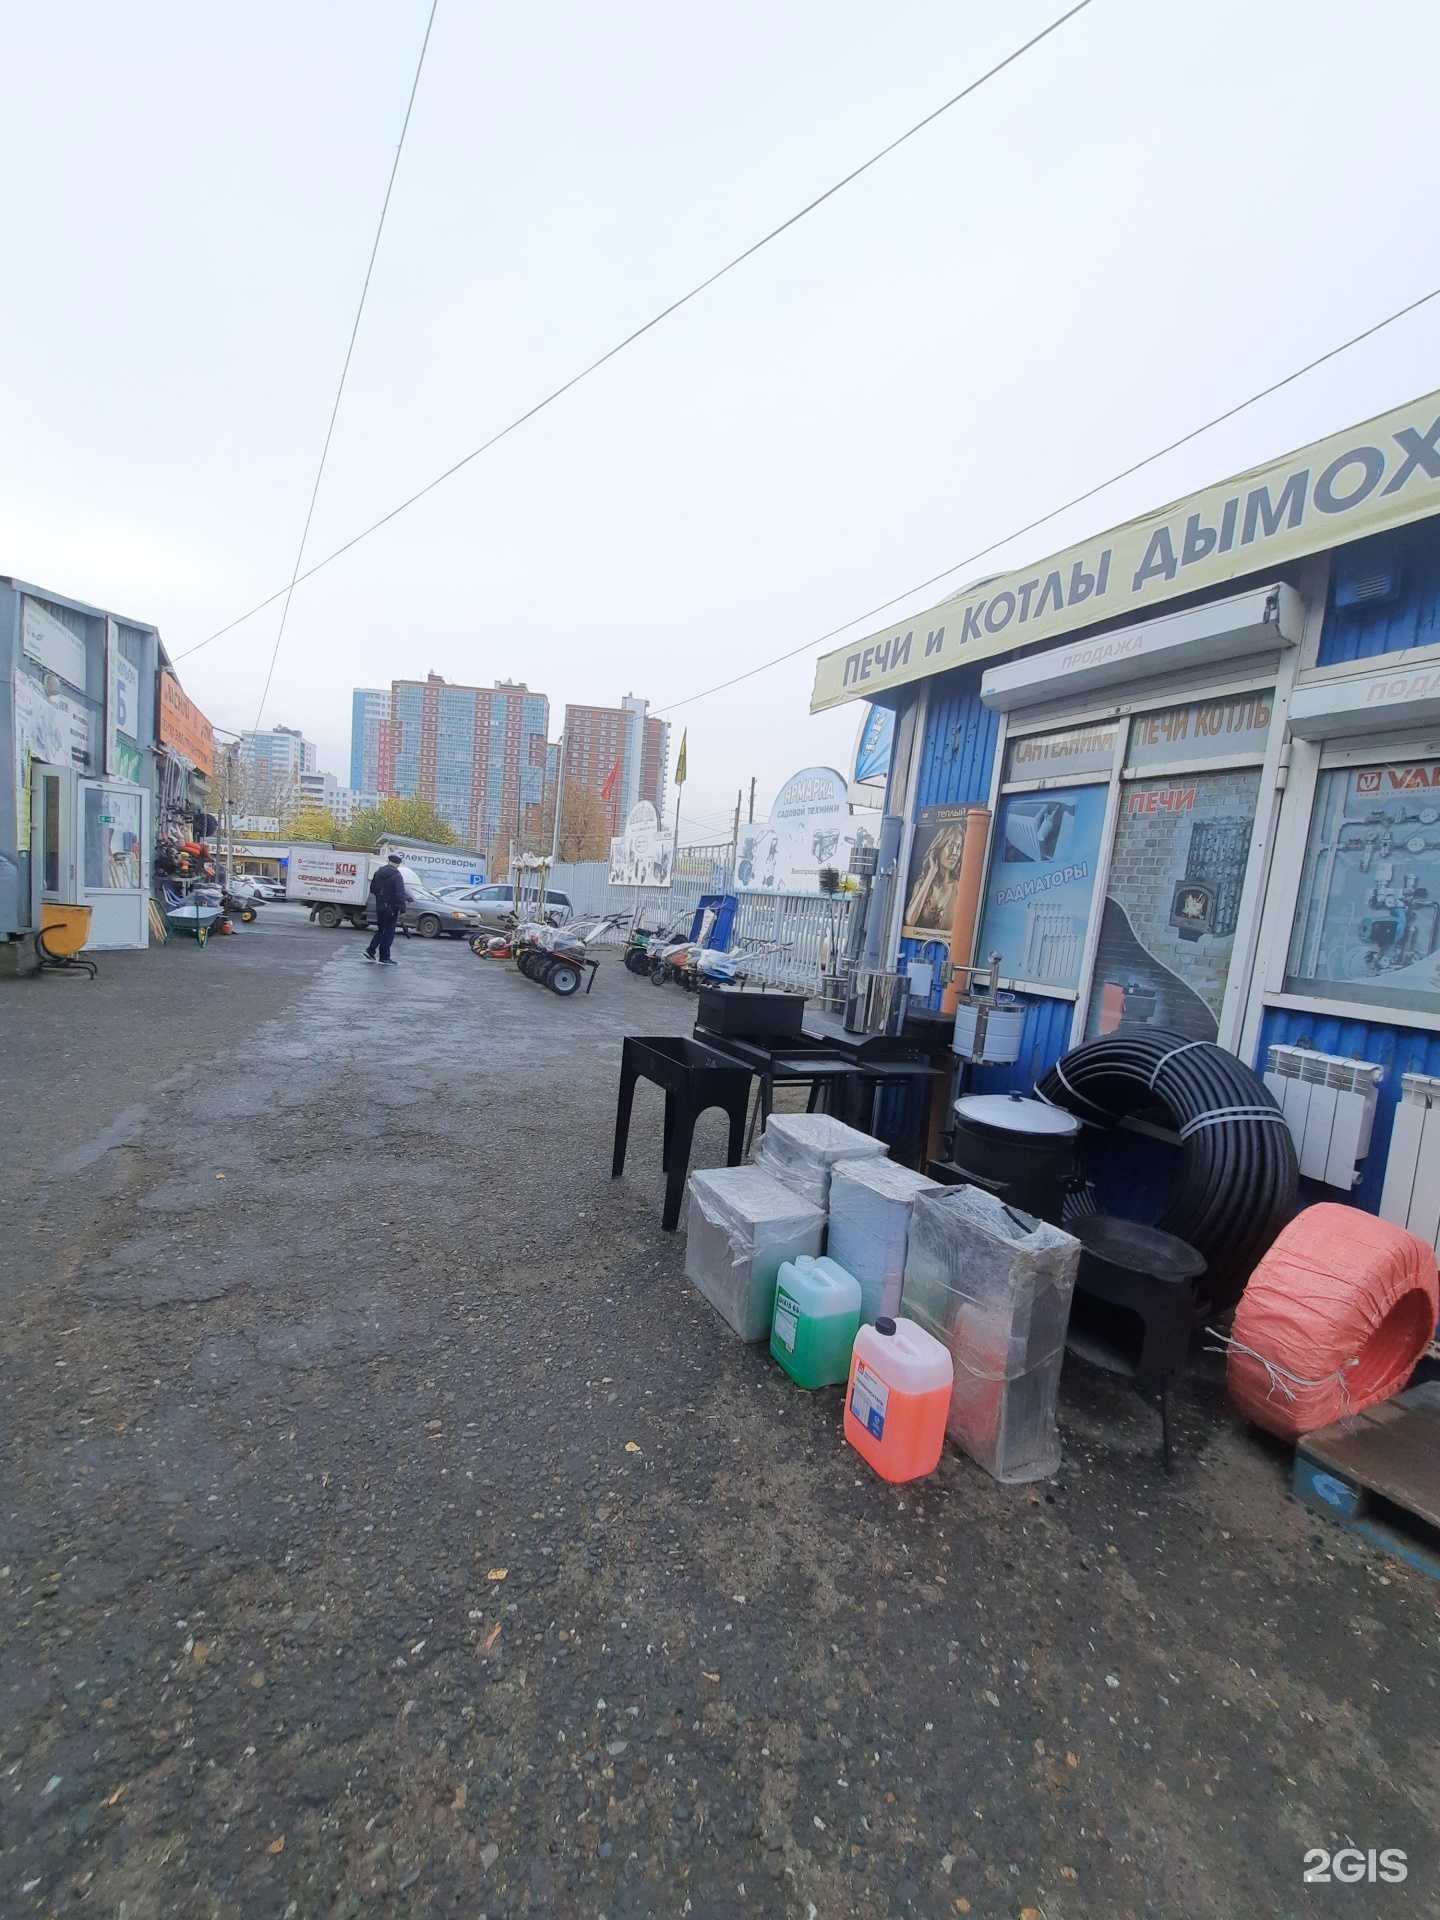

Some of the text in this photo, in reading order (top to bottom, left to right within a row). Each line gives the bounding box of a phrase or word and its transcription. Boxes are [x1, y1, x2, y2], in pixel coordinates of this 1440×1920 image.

[842, 635, 912, 687] ПЕЧИ
[924, 625, 945, 658] и
[960, 550, 1112, 646] КОТЛЫ
[1061, 632, 1144, 670] ПРОДАЖА
[1135, 706, 1188, 746] ПЕЧИ
[1127, 788, 1196, 815] ПЕЧИ
[997, 862, 1088, 905] РАДИАТОРЫ
